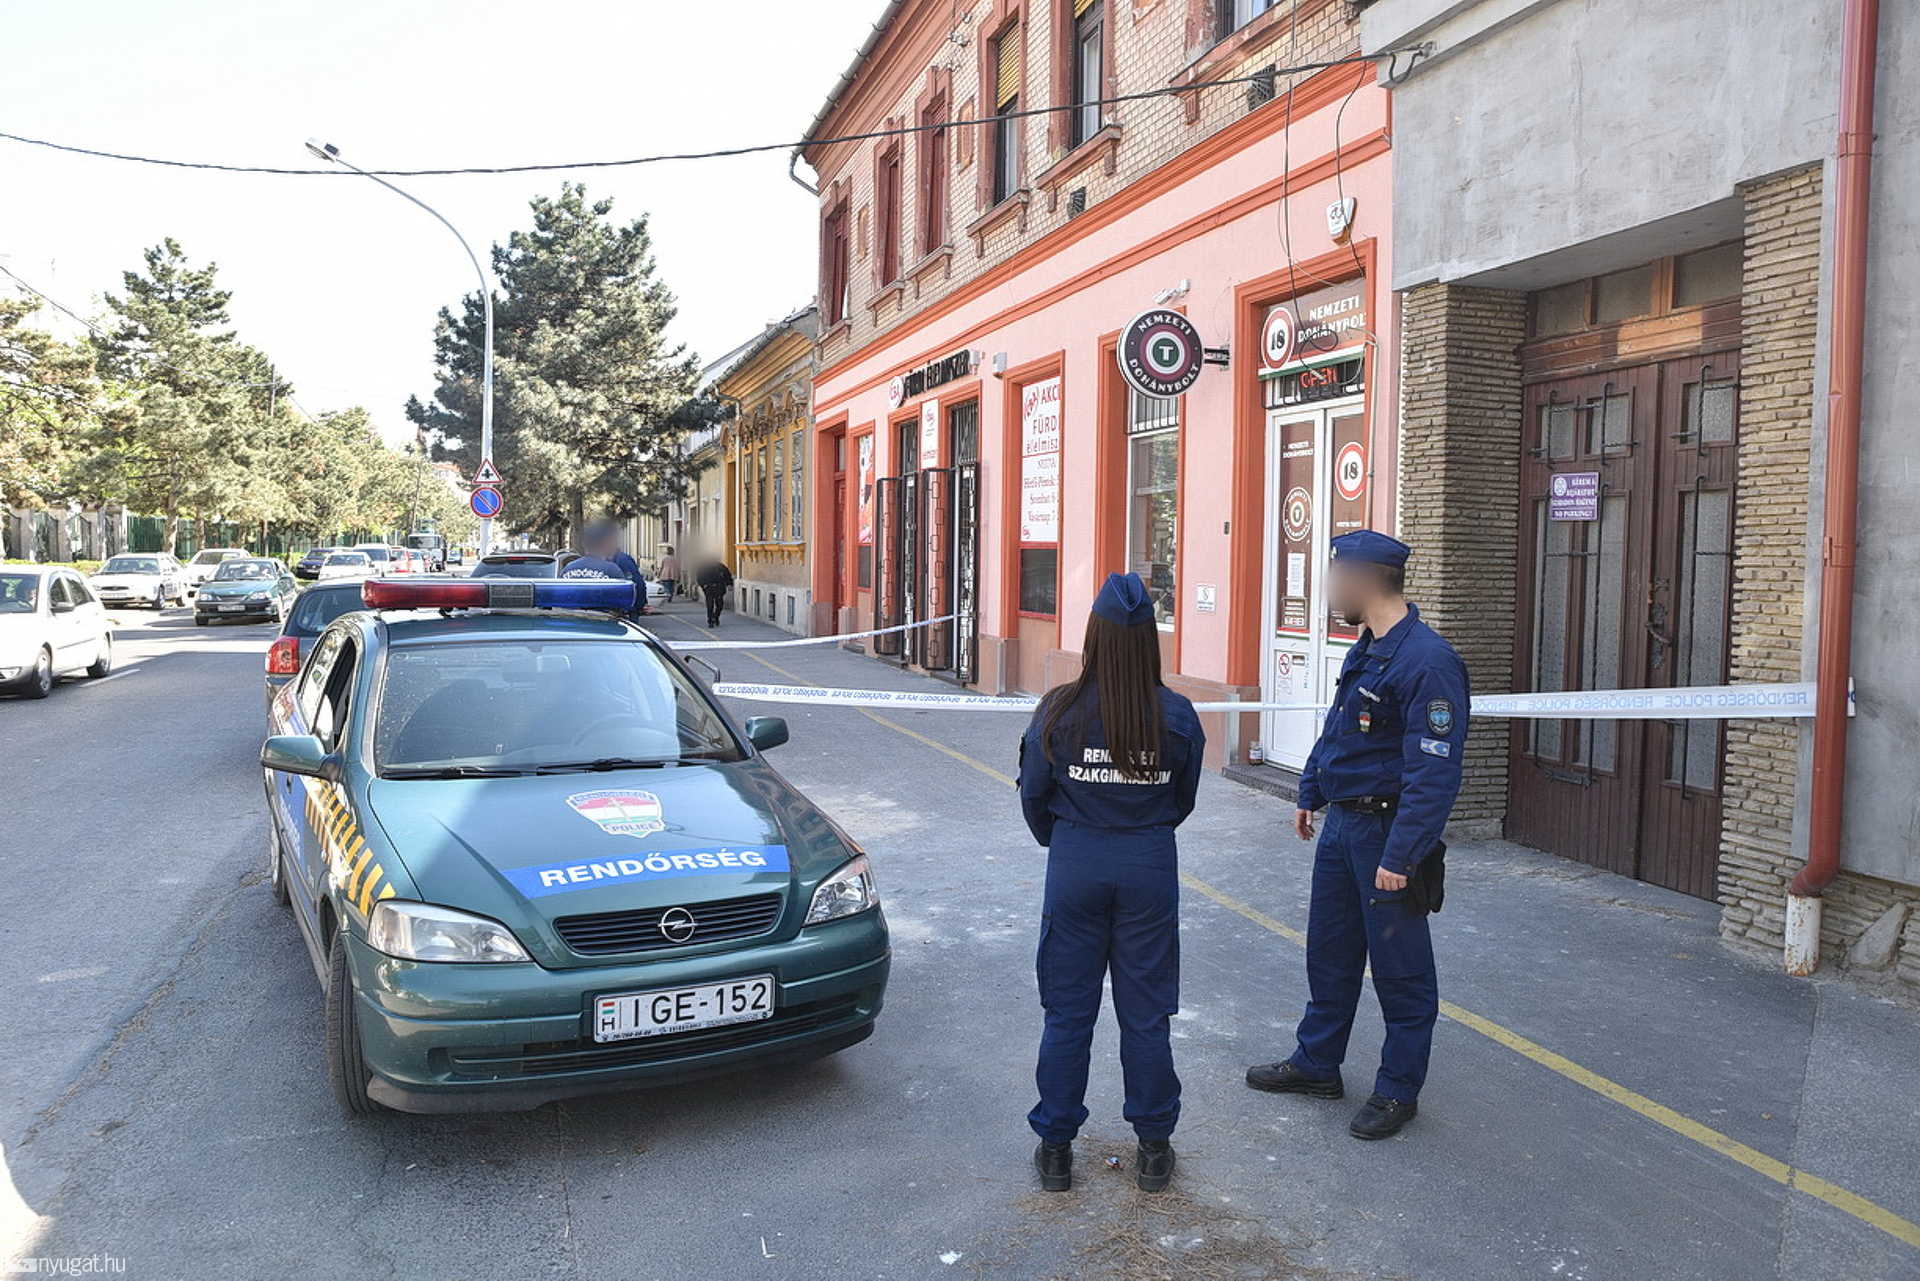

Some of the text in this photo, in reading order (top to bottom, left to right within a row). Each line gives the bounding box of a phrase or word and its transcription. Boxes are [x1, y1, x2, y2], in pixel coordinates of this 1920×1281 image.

[1309, 295, 1360, 321] NEMZETI
[1138, 314, 1192, 335] NEMZETI
[1297, 313, 1366, 342] DOHÁNYBOL
[1271, 329, 1286, 350] 18
[1159, 345, 1174, 361] T
[1128, 358, 1199, 392] DOHÁNYBOLT
[1343, 461, 1359, 480] 18
[539, 848, 767, 887] RENDŐRSÉG
[633, 982, 767, 1028] IGE-152
[601, 1018, 616, 1032] H
